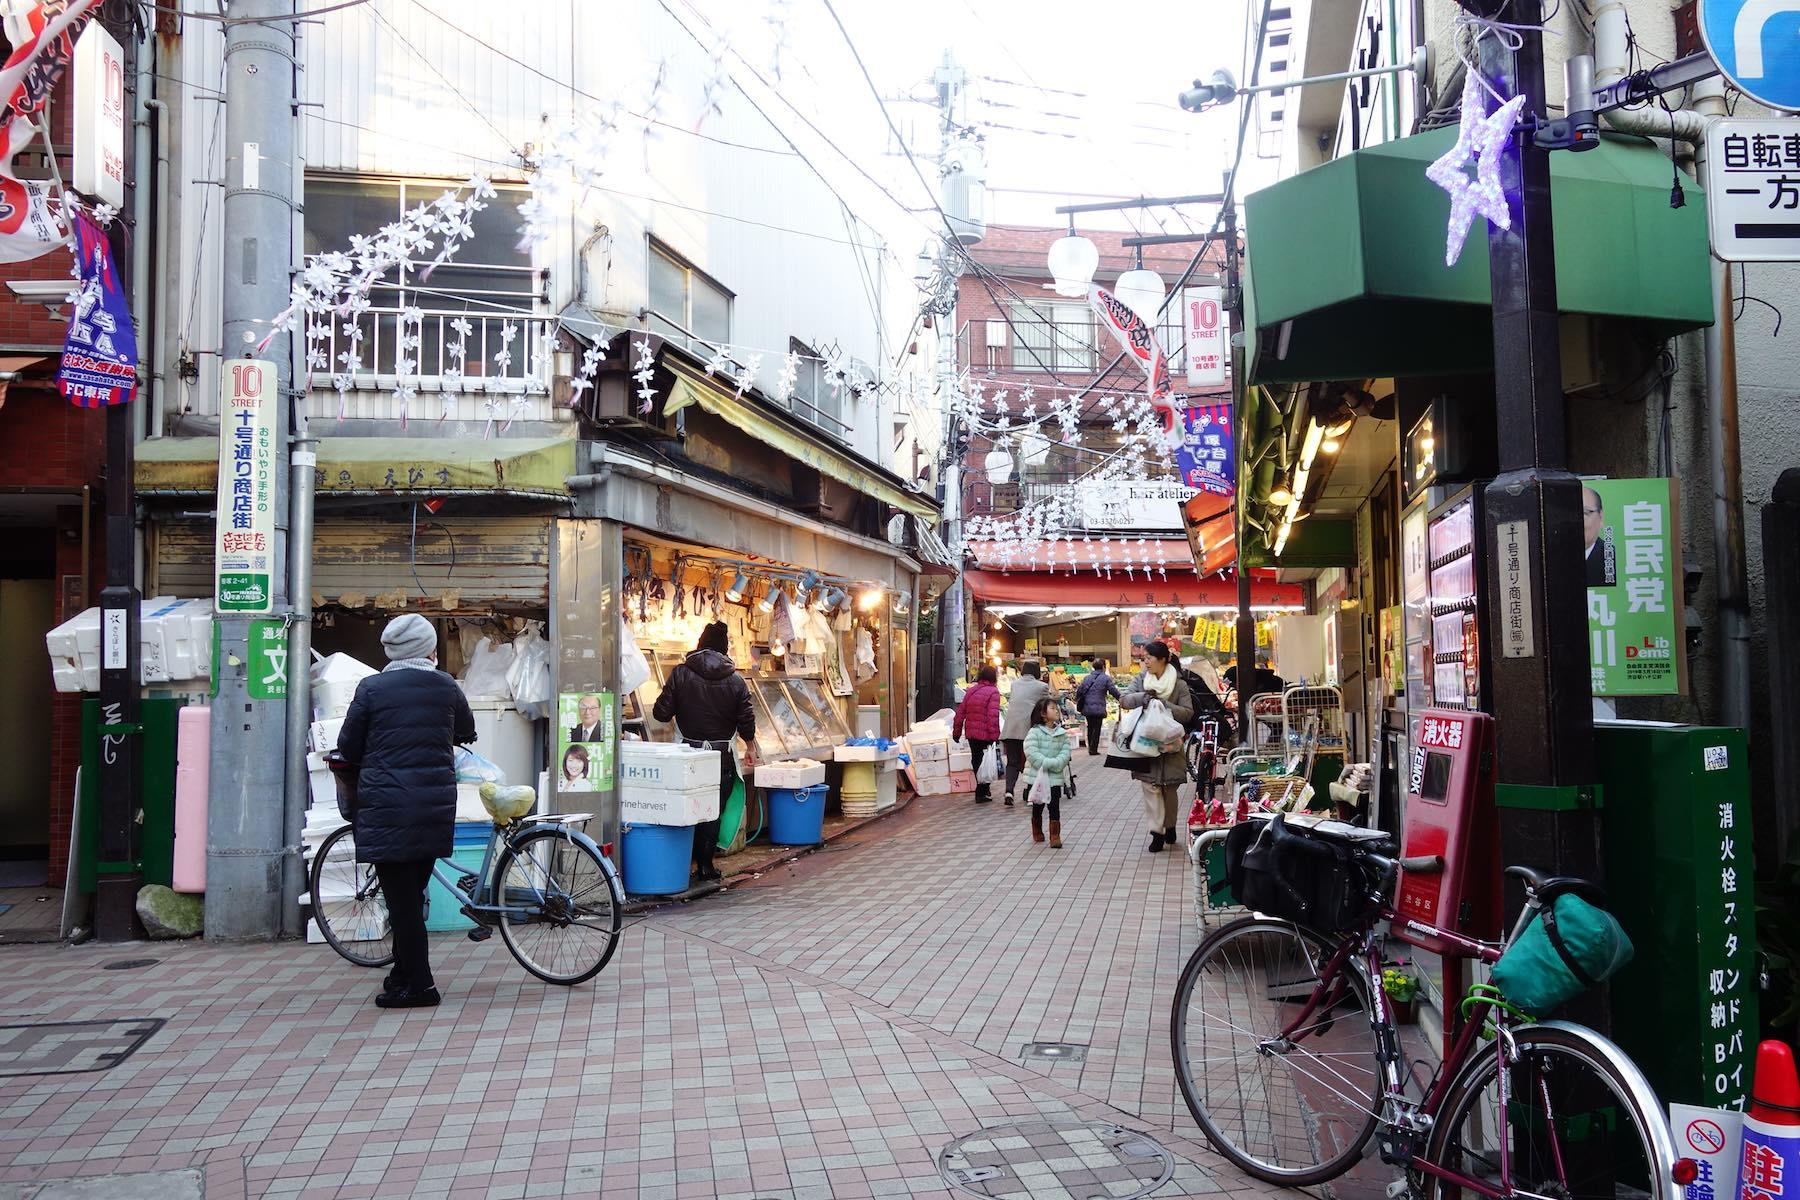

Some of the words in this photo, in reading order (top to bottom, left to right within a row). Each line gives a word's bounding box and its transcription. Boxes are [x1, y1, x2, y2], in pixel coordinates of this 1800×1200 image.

[103, 51, 122, 111] 10
[1725, 174, 1800, 210] 一方
[1190, 300, 1218, 330] 10
[1191, 330, 1219, 339] STREET
[65, 382, 112, 400] FC東京
[232, 365, 262, 397] 10
[230, 399, 263, 408] STREET
[232, 409, 256, 529] 十号通り商店街
[256, 426, 269, 512] おもいやり手形の
[1130, 487, 1154, 499] hir
[1157, 486, 1196, 500] atelier
[223, 531, 265, 542] ささはた
[1623, 501, 1665, 613] 自民党
[1507, 529, 1521, 628] 十号通り商店街
[1625, 646, 1670, 658] Dems
[1643, 636, 1670, 648] Lib
[1423, 718, 1463, 749] 消火器
[629, 766, 660, 779] H-111
[1410, 746, 1426, 795] ZEMOK
